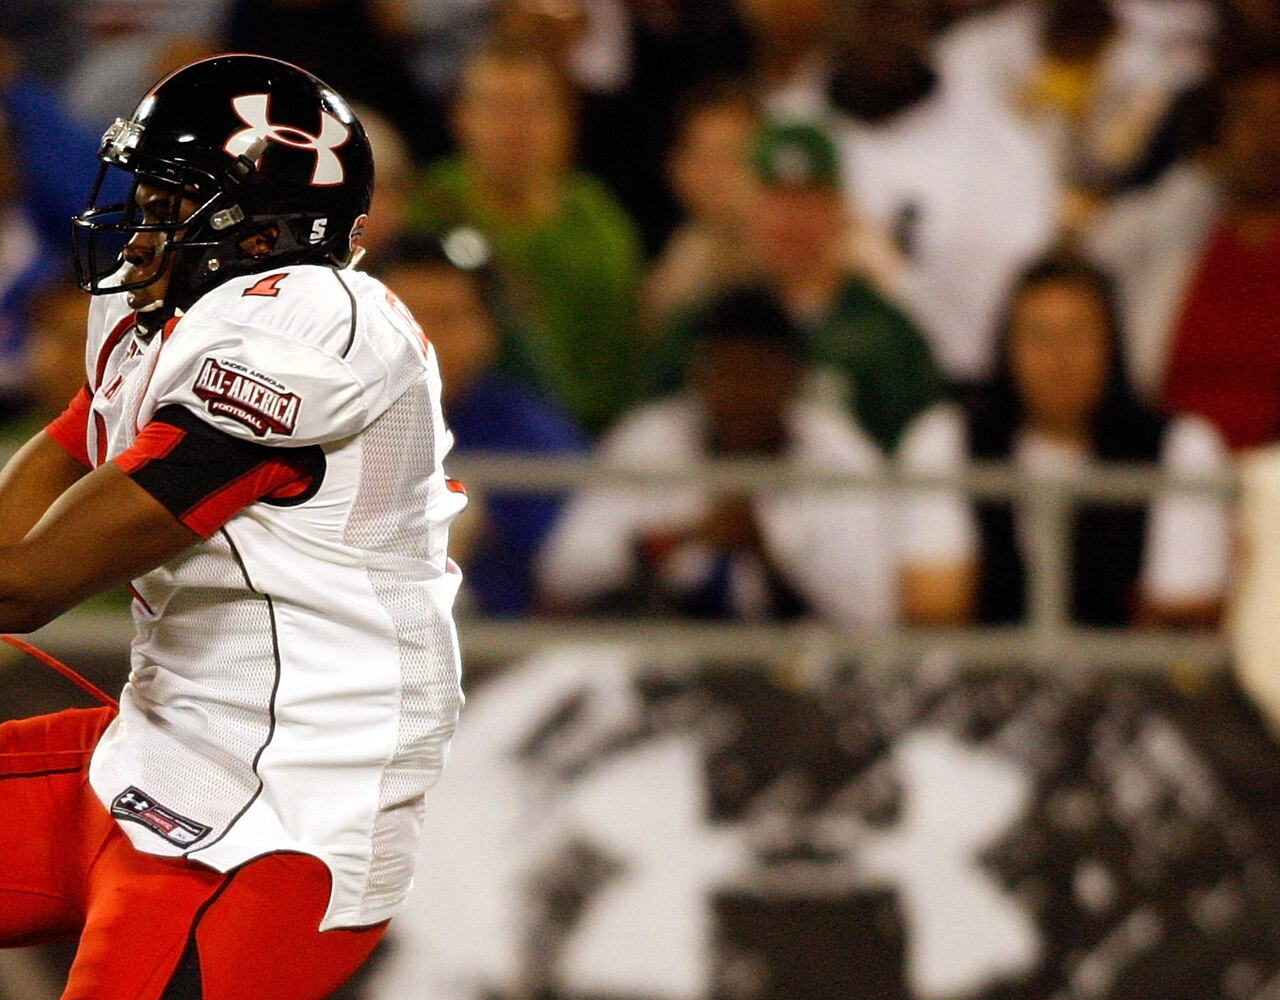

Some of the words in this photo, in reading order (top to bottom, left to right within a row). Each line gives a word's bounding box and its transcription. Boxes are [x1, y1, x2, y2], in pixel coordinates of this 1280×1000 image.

[242, 272, 290, 298] 1
[221, 359, 248, 373] UNDER
[249, 370, 286, 391] ARMOUR
[195, 360, 298, 430] ALL-AMERICA
[212, 402, 263, 430] FOOTBALL
